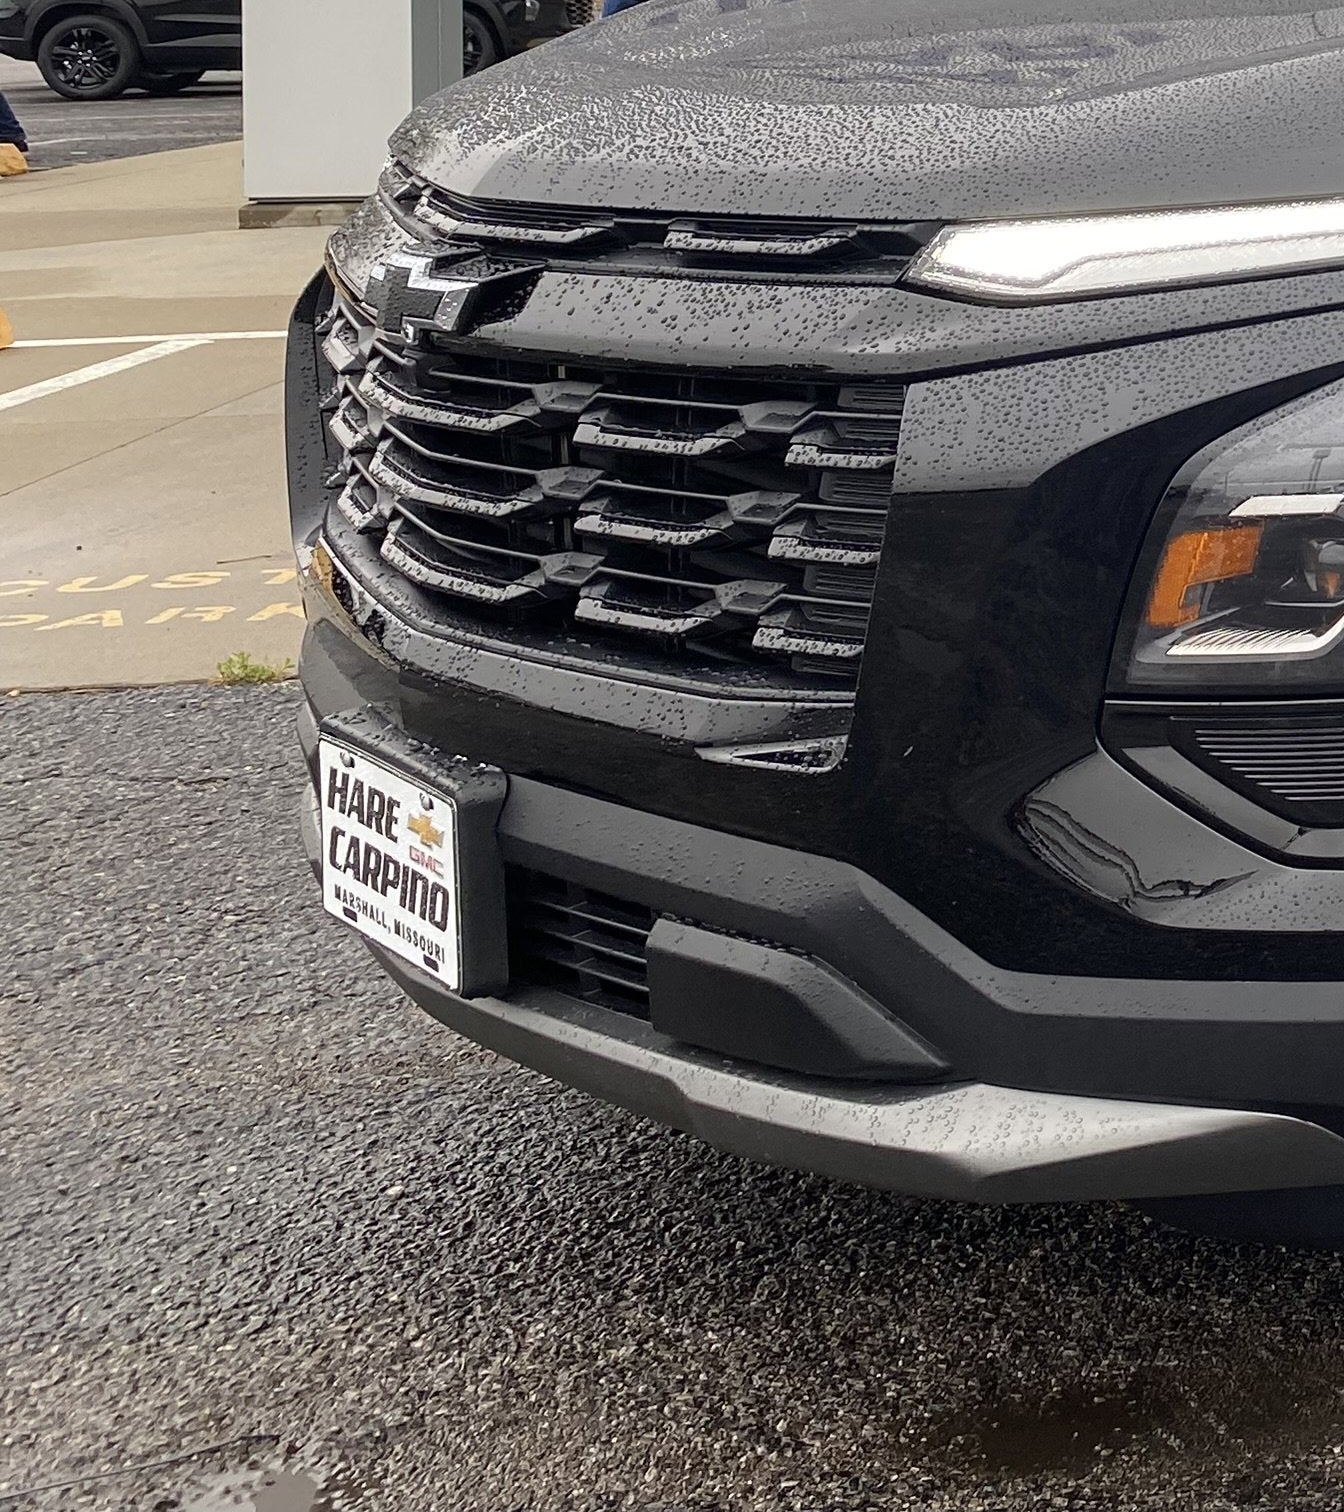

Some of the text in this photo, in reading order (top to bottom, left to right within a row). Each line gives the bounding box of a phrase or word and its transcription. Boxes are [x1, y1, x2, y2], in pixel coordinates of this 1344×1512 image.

[327, 765, 402, 844] HARE
[328, 824, 450, 933] CARPINO
[408, 844, 446, 879] GMC
[333, 882, 446, 965] MARSHALL, MISSOURI
